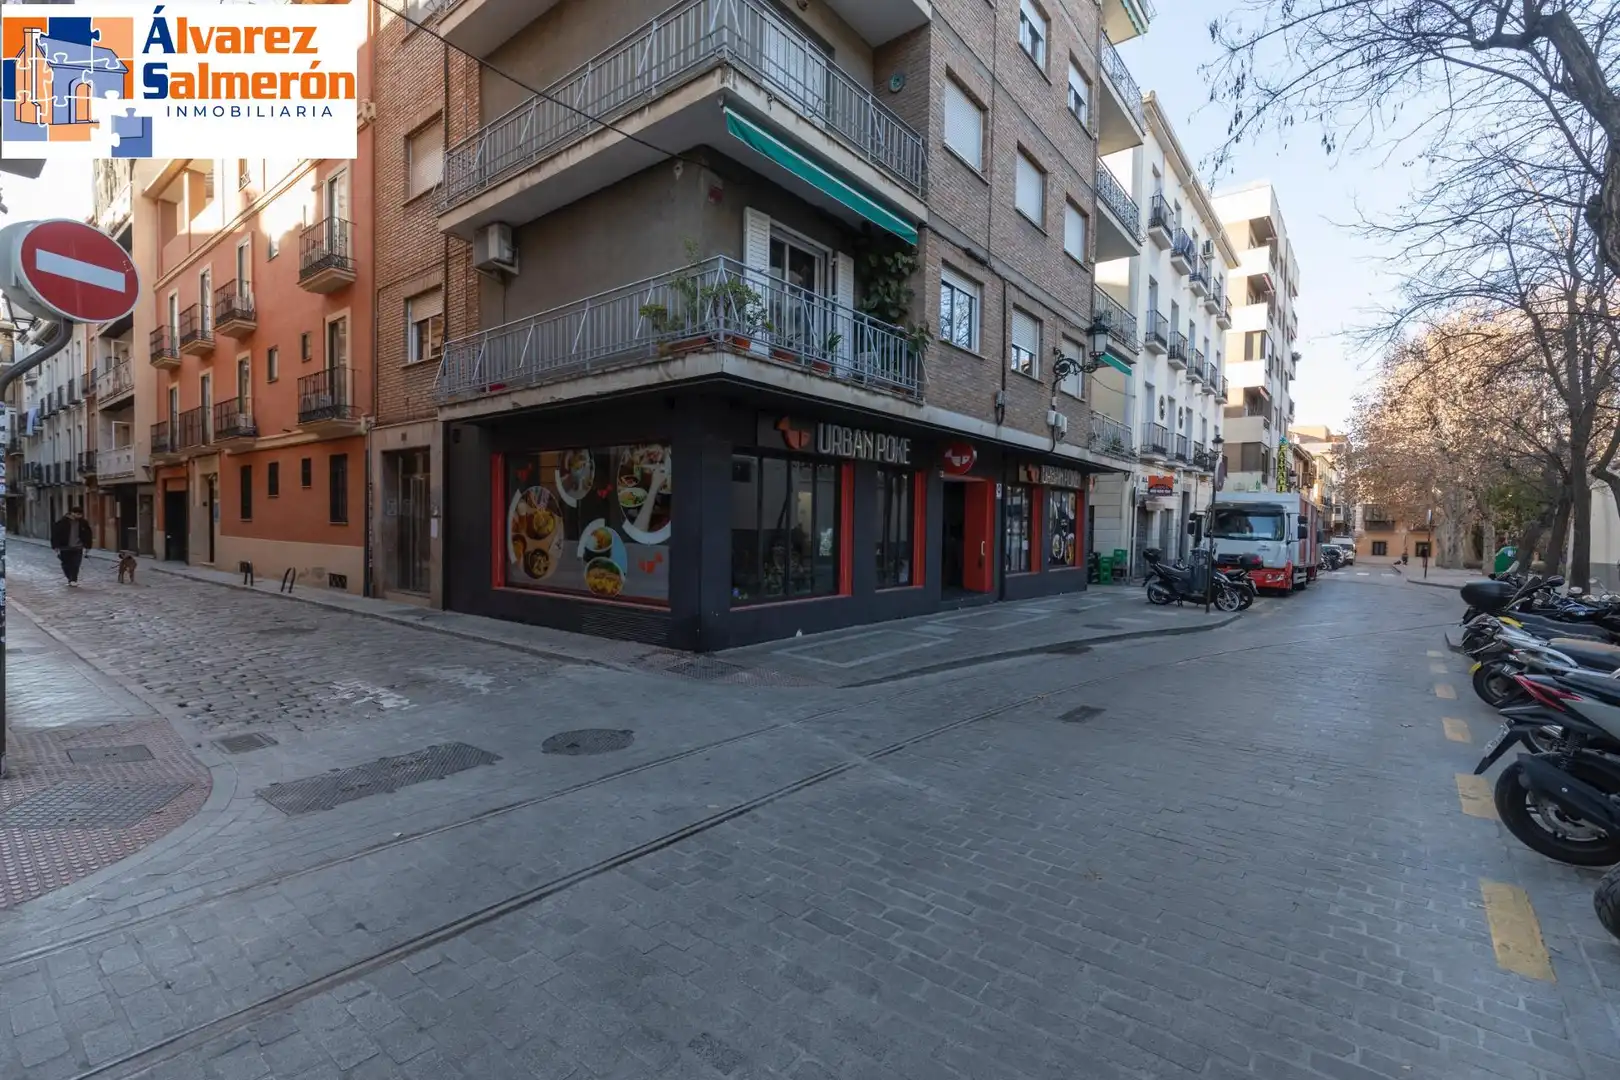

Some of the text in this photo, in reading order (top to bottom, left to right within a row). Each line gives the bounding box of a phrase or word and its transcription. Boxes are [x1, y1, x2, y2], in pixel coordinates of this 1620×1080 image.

[817, 422, 912, 465] URBAN POKE
[1277, 444, 1288, 492] FARMACI
